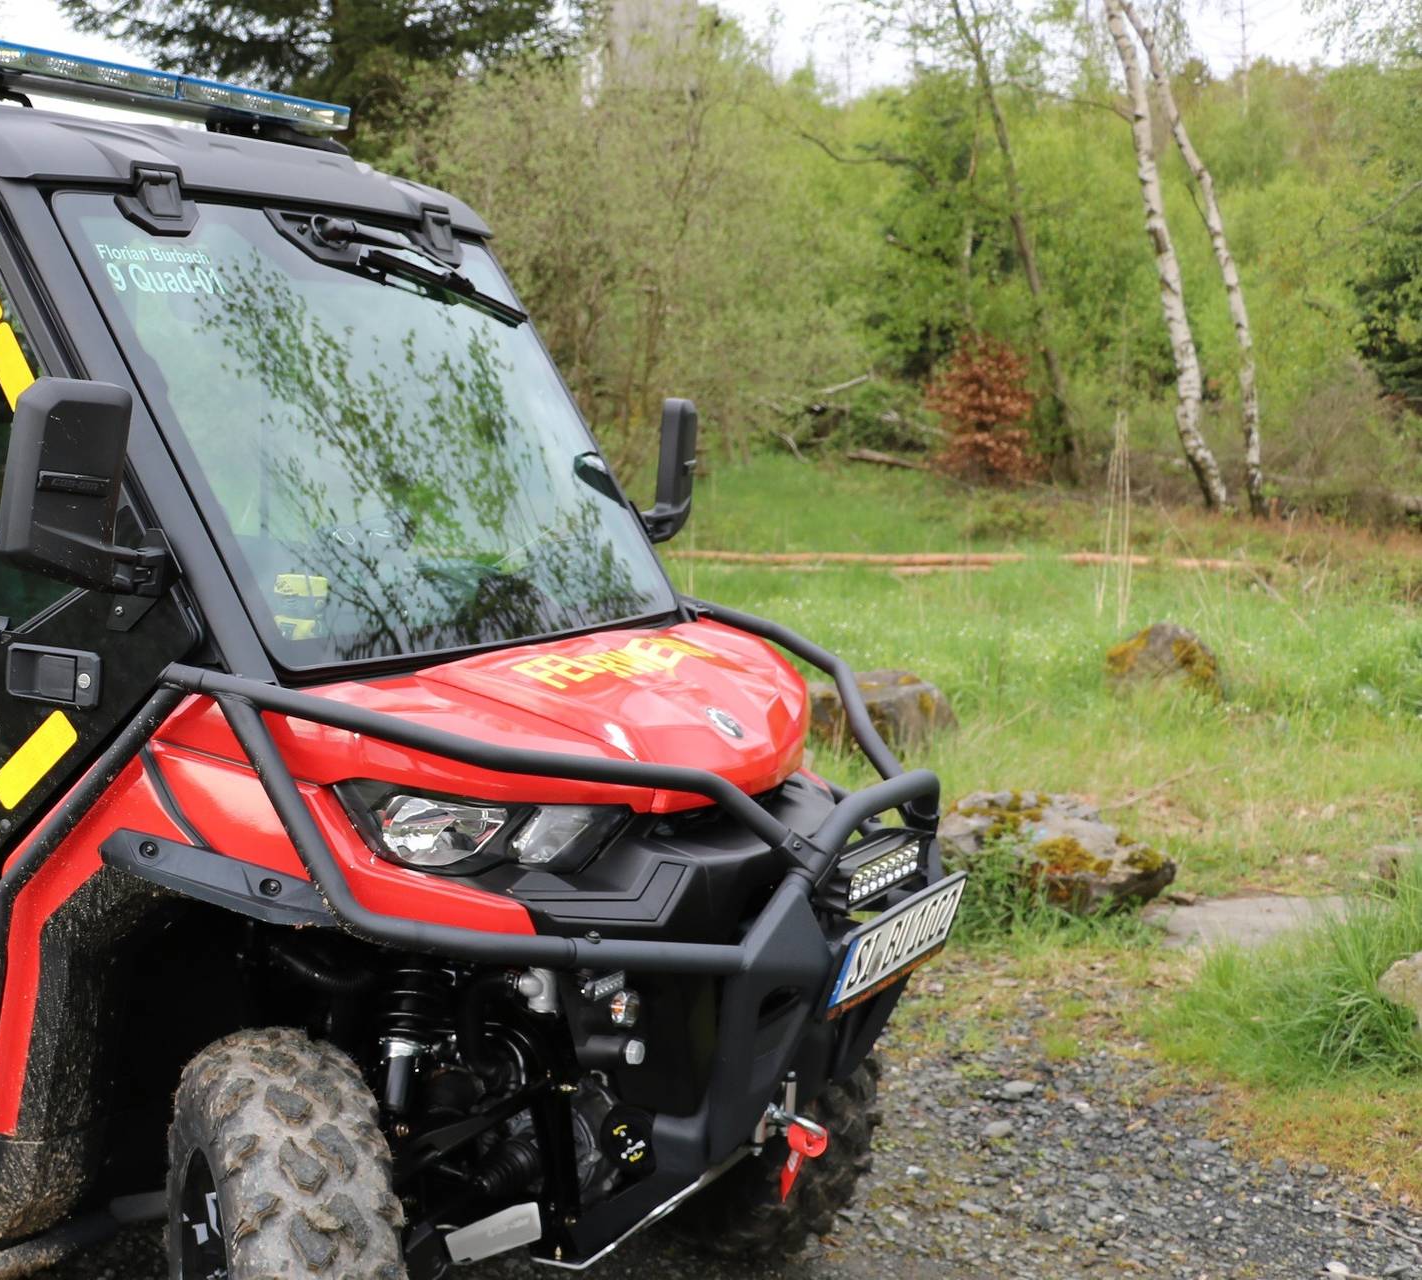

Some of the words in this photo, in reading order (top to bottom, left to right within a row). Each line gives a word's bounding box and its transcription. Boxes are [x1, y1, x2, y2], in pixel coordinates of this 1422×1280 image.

[95, 243, 150, 262] Florian
[150, 247, 211, 265] Burbach
[106, 262, 127, 292] 9
[128, 263, 226, 295] Quad-01
